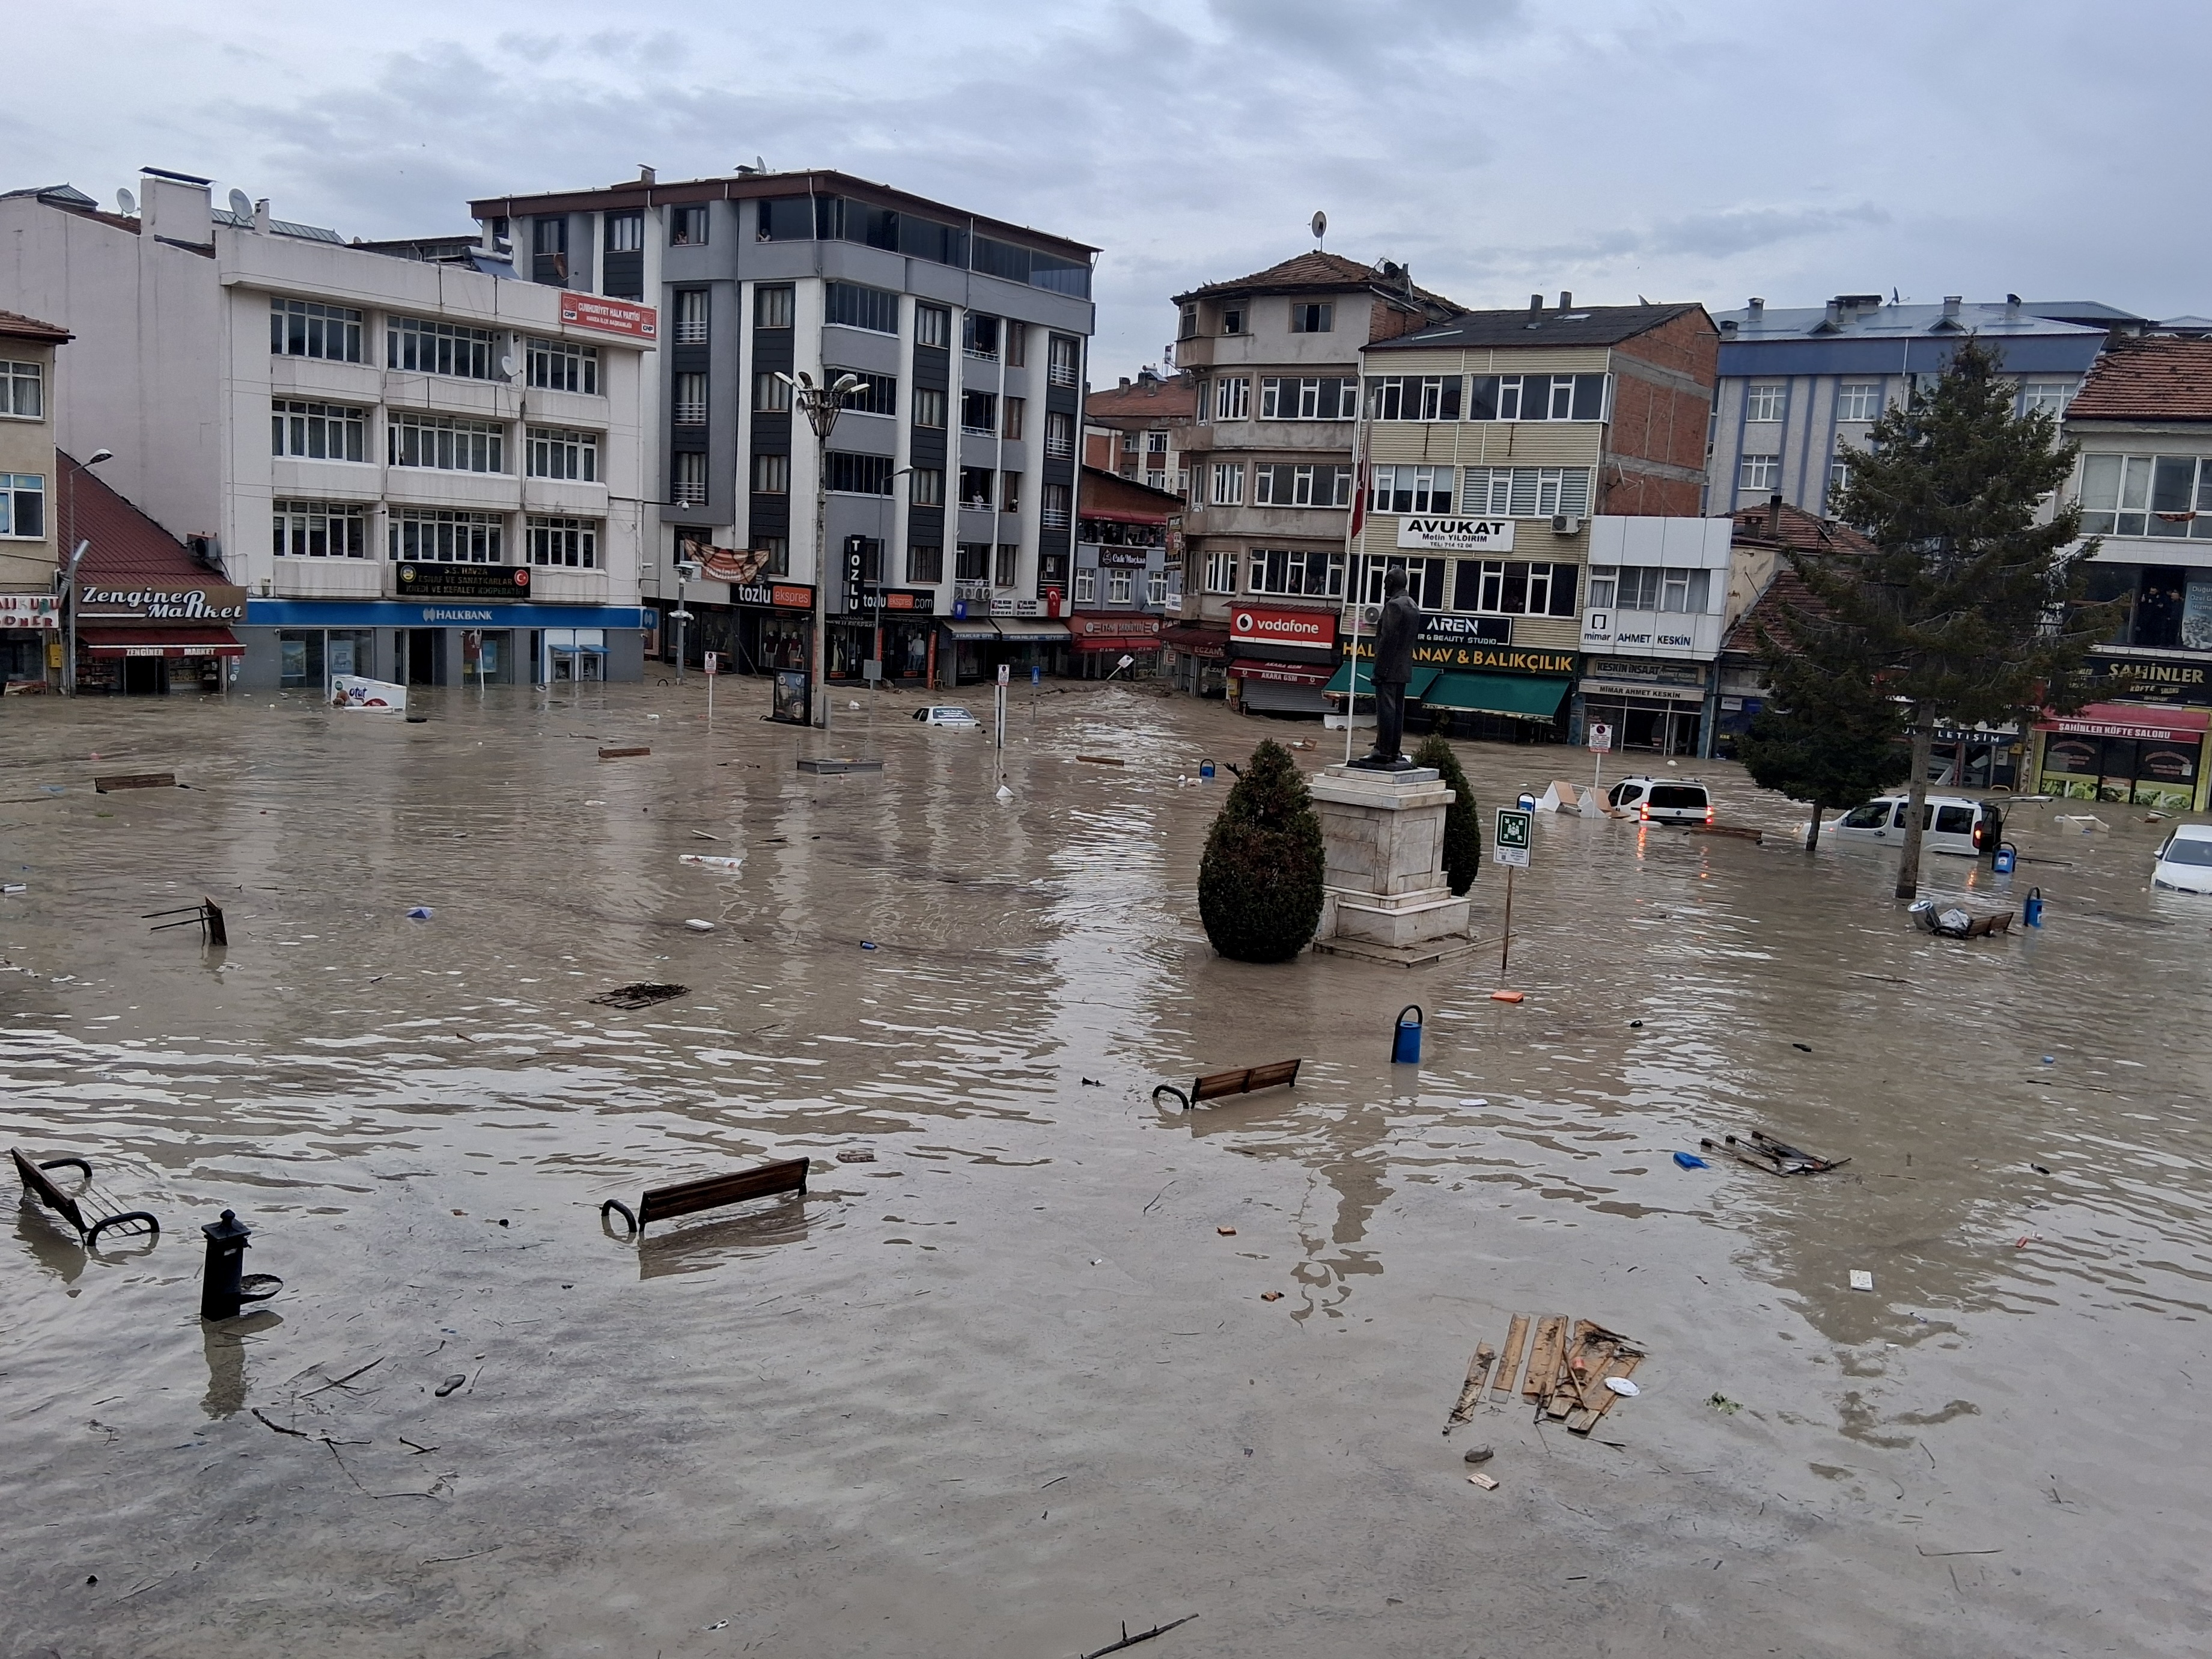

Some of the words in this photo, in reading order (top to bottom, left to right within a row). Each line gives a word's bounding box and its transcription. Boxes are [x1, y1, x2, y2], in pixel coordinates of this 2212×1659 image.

[609, 307, 623, 319] HALK
[1407, 519, 1505, 535] AVUKAT
[849, 540, 861, 610] TOZLU
[739, 584, 771, 603] tozlu
[775, 589, 809, 604] ekspres
[889, 596, 912, 606] ekspres
[436, 610, 493, 620] HALKBANK
[1257, 619, 1319, 634] vodafone
[1427, 616, 1478, 635] AREN
[1433, 635, 1464, 643] BEAUTY
[1617, 633, 1652, 644] AHMET
[1657, 634, 1691, 646] KESKİN
[184, 647, 216, 656] MARKET
[1457, 650, 1469, 664] &
[1473, 650, 1574, 673] BALIKÇILIK
[1261, 672, 1282, 680] AKARA
[2109, 663, 2205, 683] ŞAHİNLER
[1600, 686, 1624, 694] MİMAR
[1937, 730, 2000, 742] LETİŞİM
[2104, 725, 2133, 736] KÖFTE
[2134, 729, 2171, 739] SALONU
